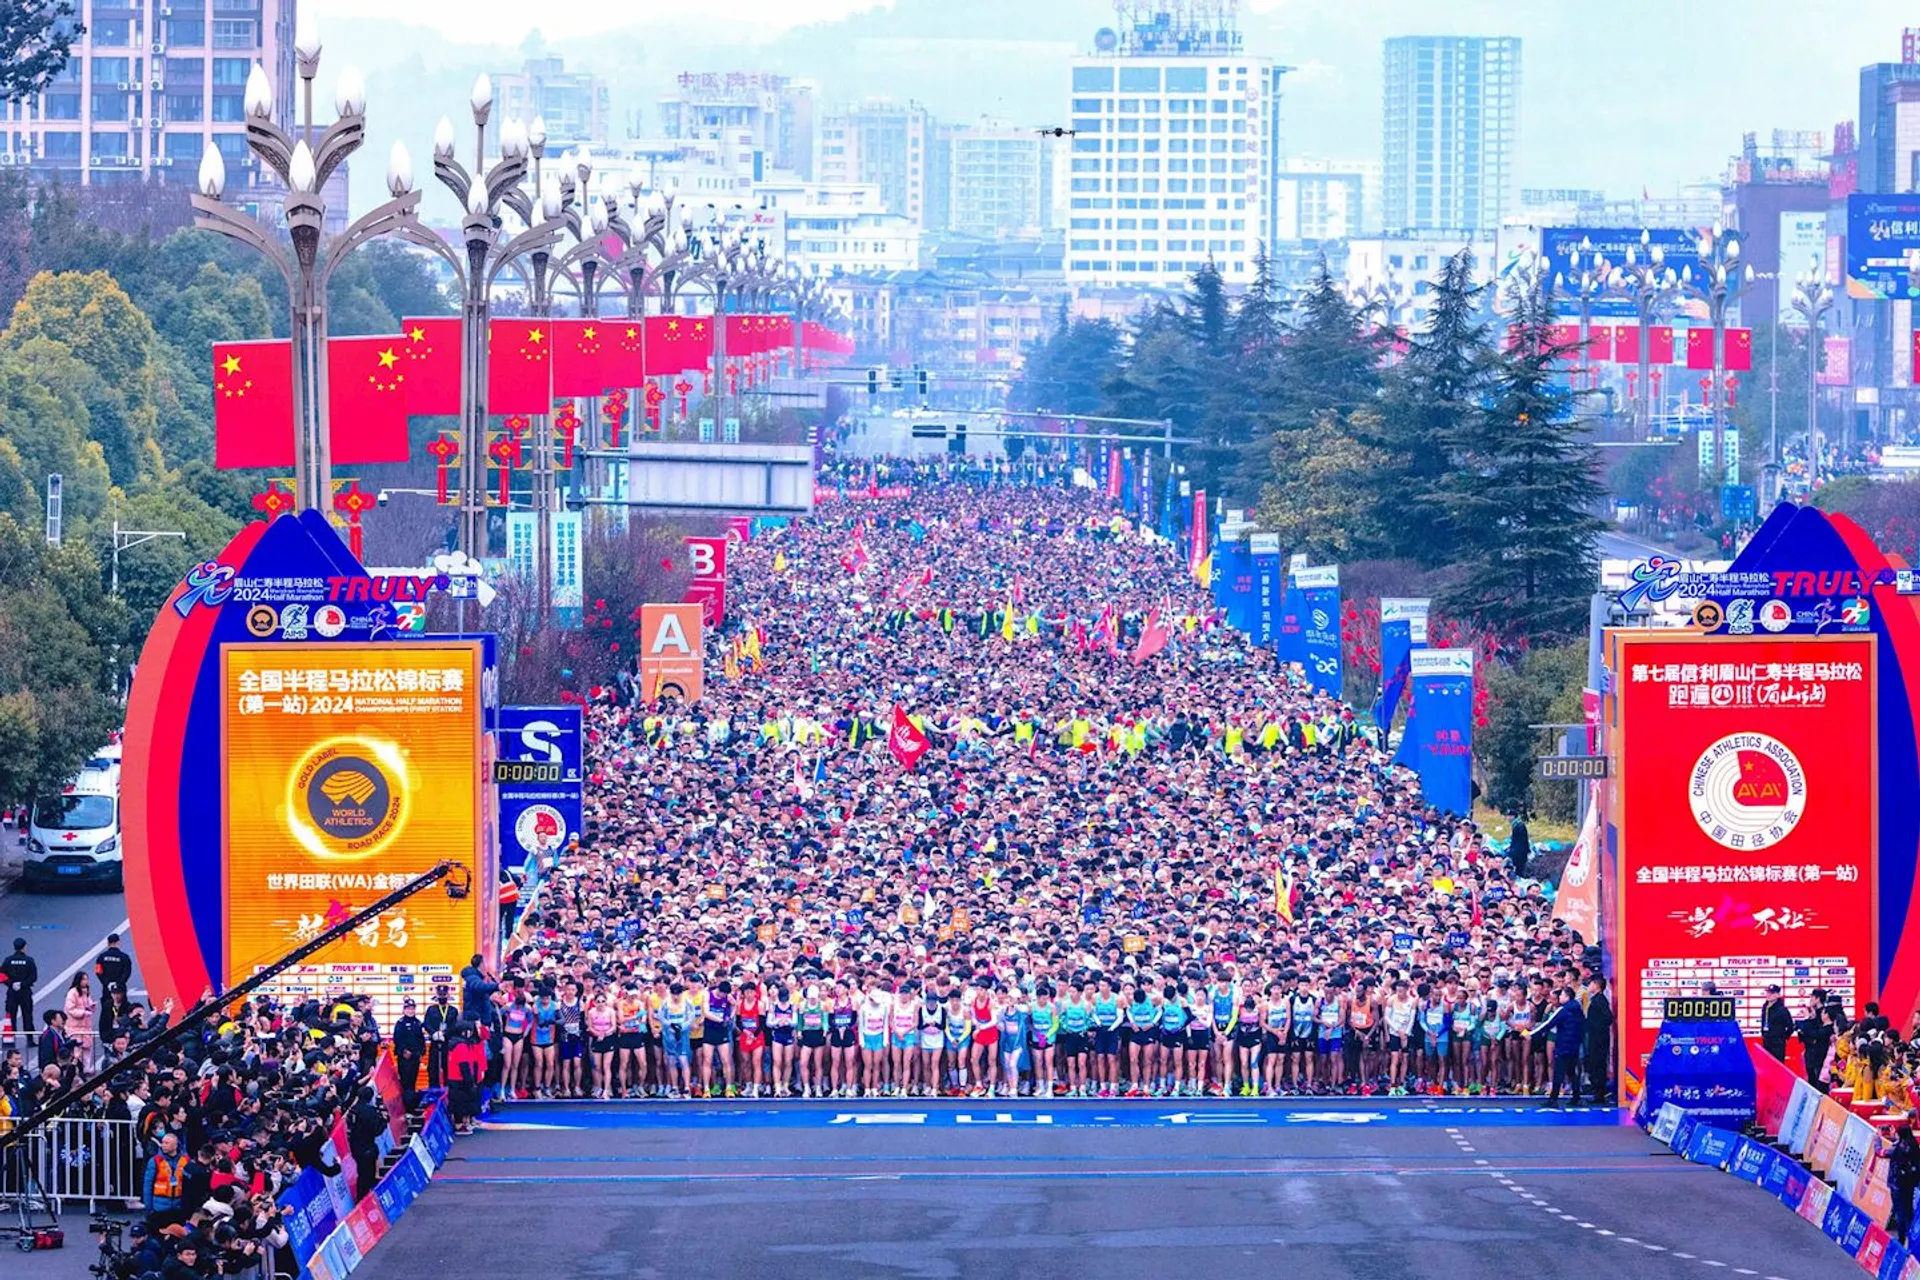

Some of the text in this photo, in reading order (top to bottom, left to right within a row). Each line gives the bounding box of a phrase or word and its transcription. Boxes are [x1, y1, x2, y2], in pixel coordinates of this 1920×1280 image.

[691, 543, 715, 575] B
[233, 577, 324, 588] 眉山仁寿半程马拉松
[1679, 572, 1770, 583] 眉山仁寿半程马拉松
[1771, 570, 1879, 596] TRULY
[233, 588, 269, 601] 2024
[288, 593, 324, 601] Marathon
[327, 575, 436, 601] TRULY
[1679, 583, 1715, 597] 2024
[651, 613, 691, 654] A
[238, 669, 464, 692] 全国半程马拉松锦标赛
[1632, 663, 1863, 684] 第七届信利眉山仁寿半程马拉松
[310, 696, 354, 714] 2024
[355, 697, 463, 705] NATIONAL HALF MARATHON
[520, 720, 563, 763] S
[498, 765, 559, 781] 0:00:00
[1543, 760, 1604, 776] 0:00:00
[1693, 736, 1803, 797] CHINESE ATHLETICS ASSOCIATION
[299, 764, 314, 789] GOLD
[323, 817, 373, 826] ATHLETICS
[332, 808, 366, 817] WORLD
[1700, 809, 1798, 847] 中国田径协会
[1636, 865, 1858, 883] 全国半程马拉松锦标赛(第一站)
[1668, 1001, 1732, 1017] 0:00:00
